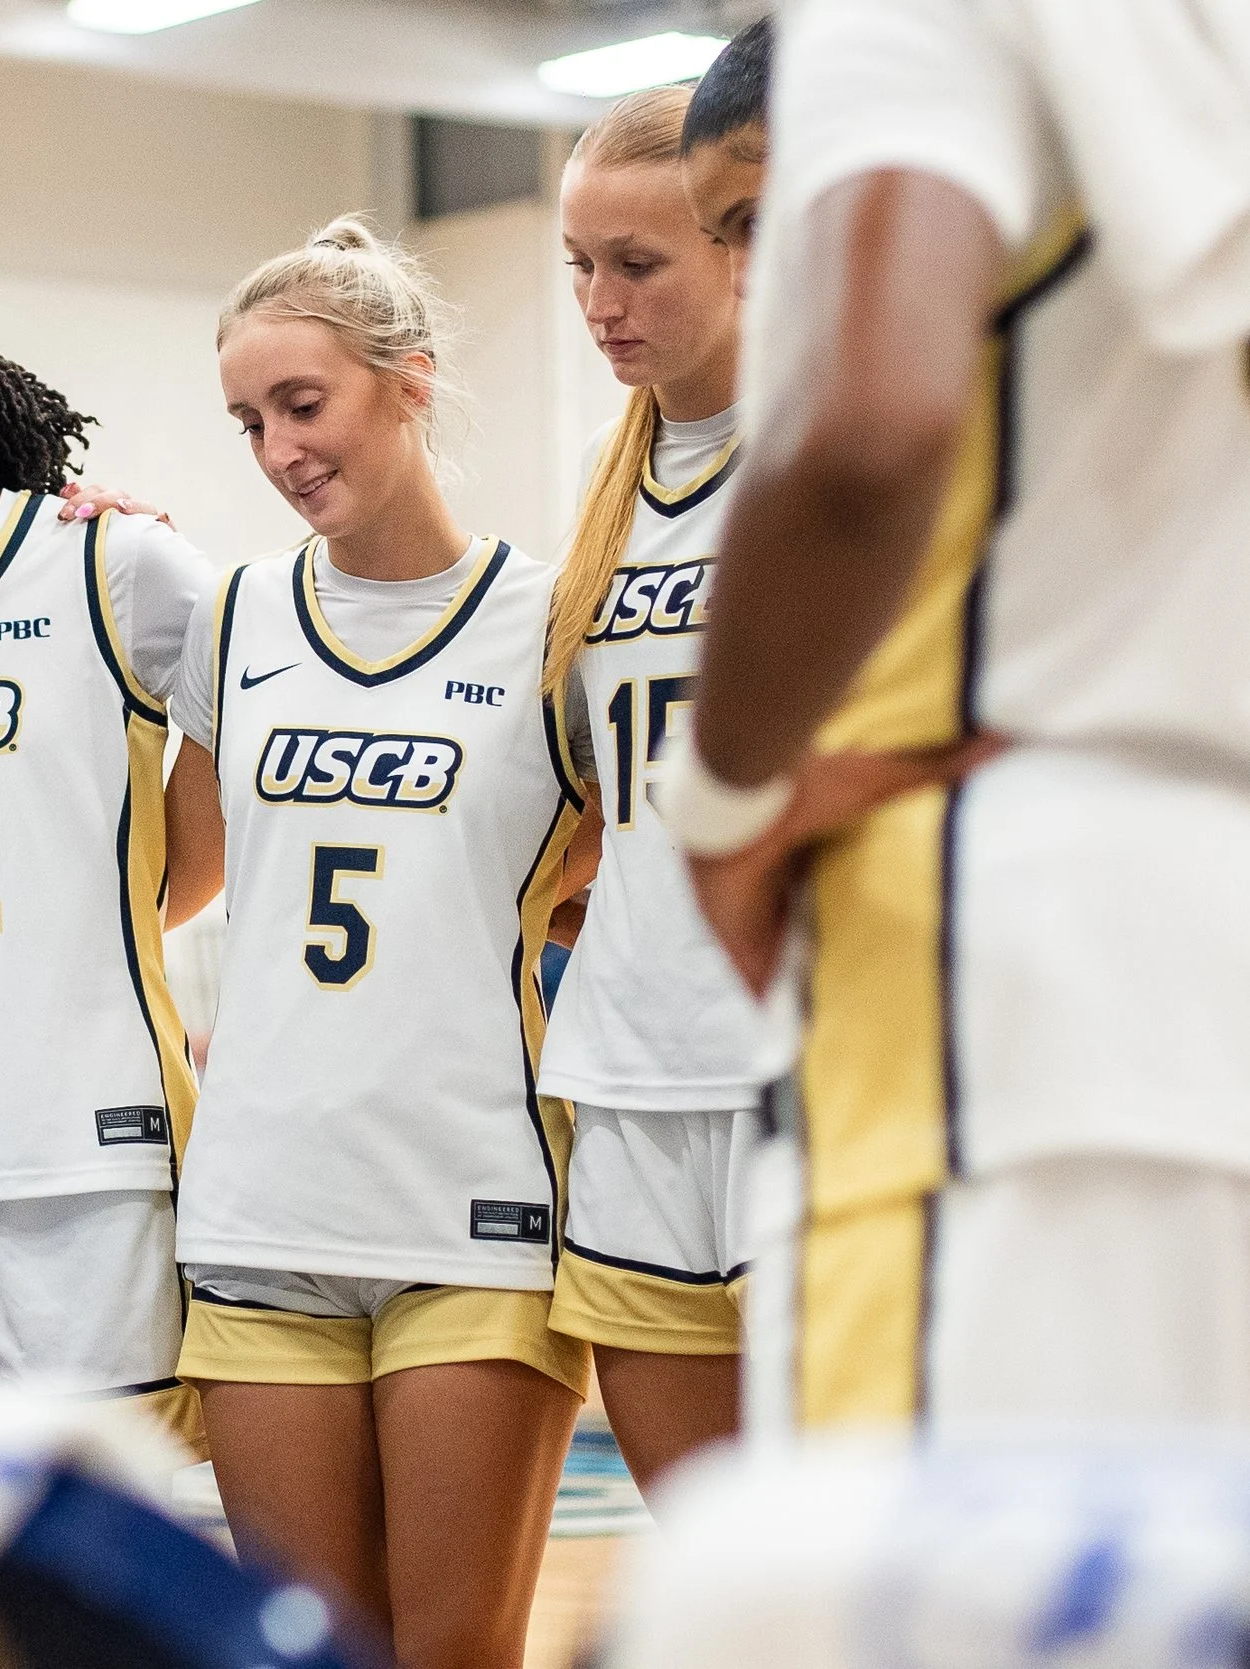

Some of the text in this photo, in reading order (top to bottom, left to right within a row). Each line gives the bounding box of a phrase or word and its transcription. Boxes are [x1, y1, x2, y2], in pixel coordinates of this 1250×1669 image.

[445, 680, 505, 706] PBC
[257, 728, 463, 808] USCB
[303, 843, 382, 988] 5
[150, 1117, 160, 1131] M
[529, 1215, 542, 1231] M
